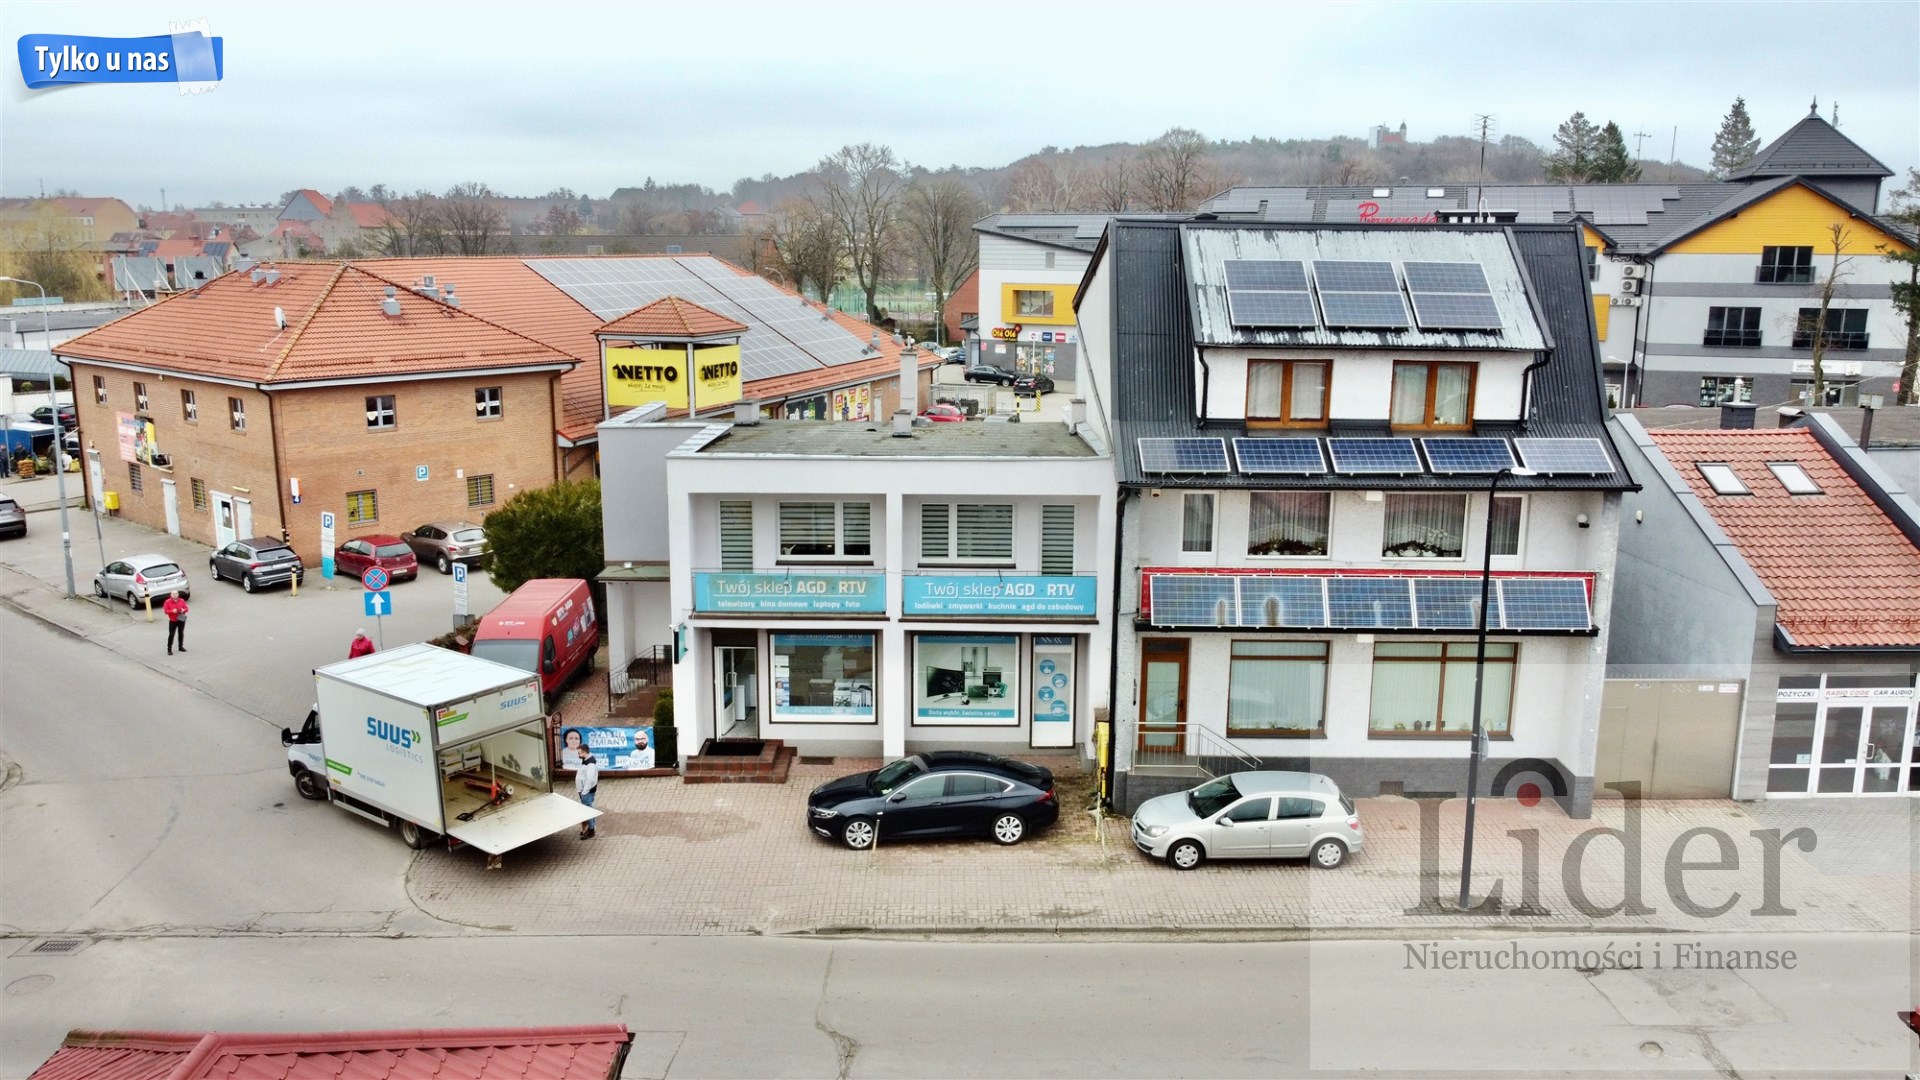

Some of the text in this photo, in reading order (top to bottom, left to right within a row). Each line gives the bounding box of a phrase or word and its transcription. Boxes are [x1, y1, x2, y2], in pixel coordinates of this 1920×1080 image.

[612, 364, 677, 382] NETTO
[701, 361, 738, 380] NETTO
[717, 580, 866, 596] Twój sklep AGD RTV
[925, 582, 1075, 599] Twój sklep AGD RTV
[718, 600, 860, 609] telewizory kina domowe laptopy foto
[948, 602, 983, 610] zmywarki
[988, 602, 1016, 610] kuchnie
[1021, 603, 1036, 611] agd
[1047, 603, 1084, 612] zabudowy
[500, 695, 527, 710] SUUS
[367, 716, 412, 749] SUUS
[590, 738, 626, 746] ZMIANY
[386, 743, 424, 764] LOGISTICS
